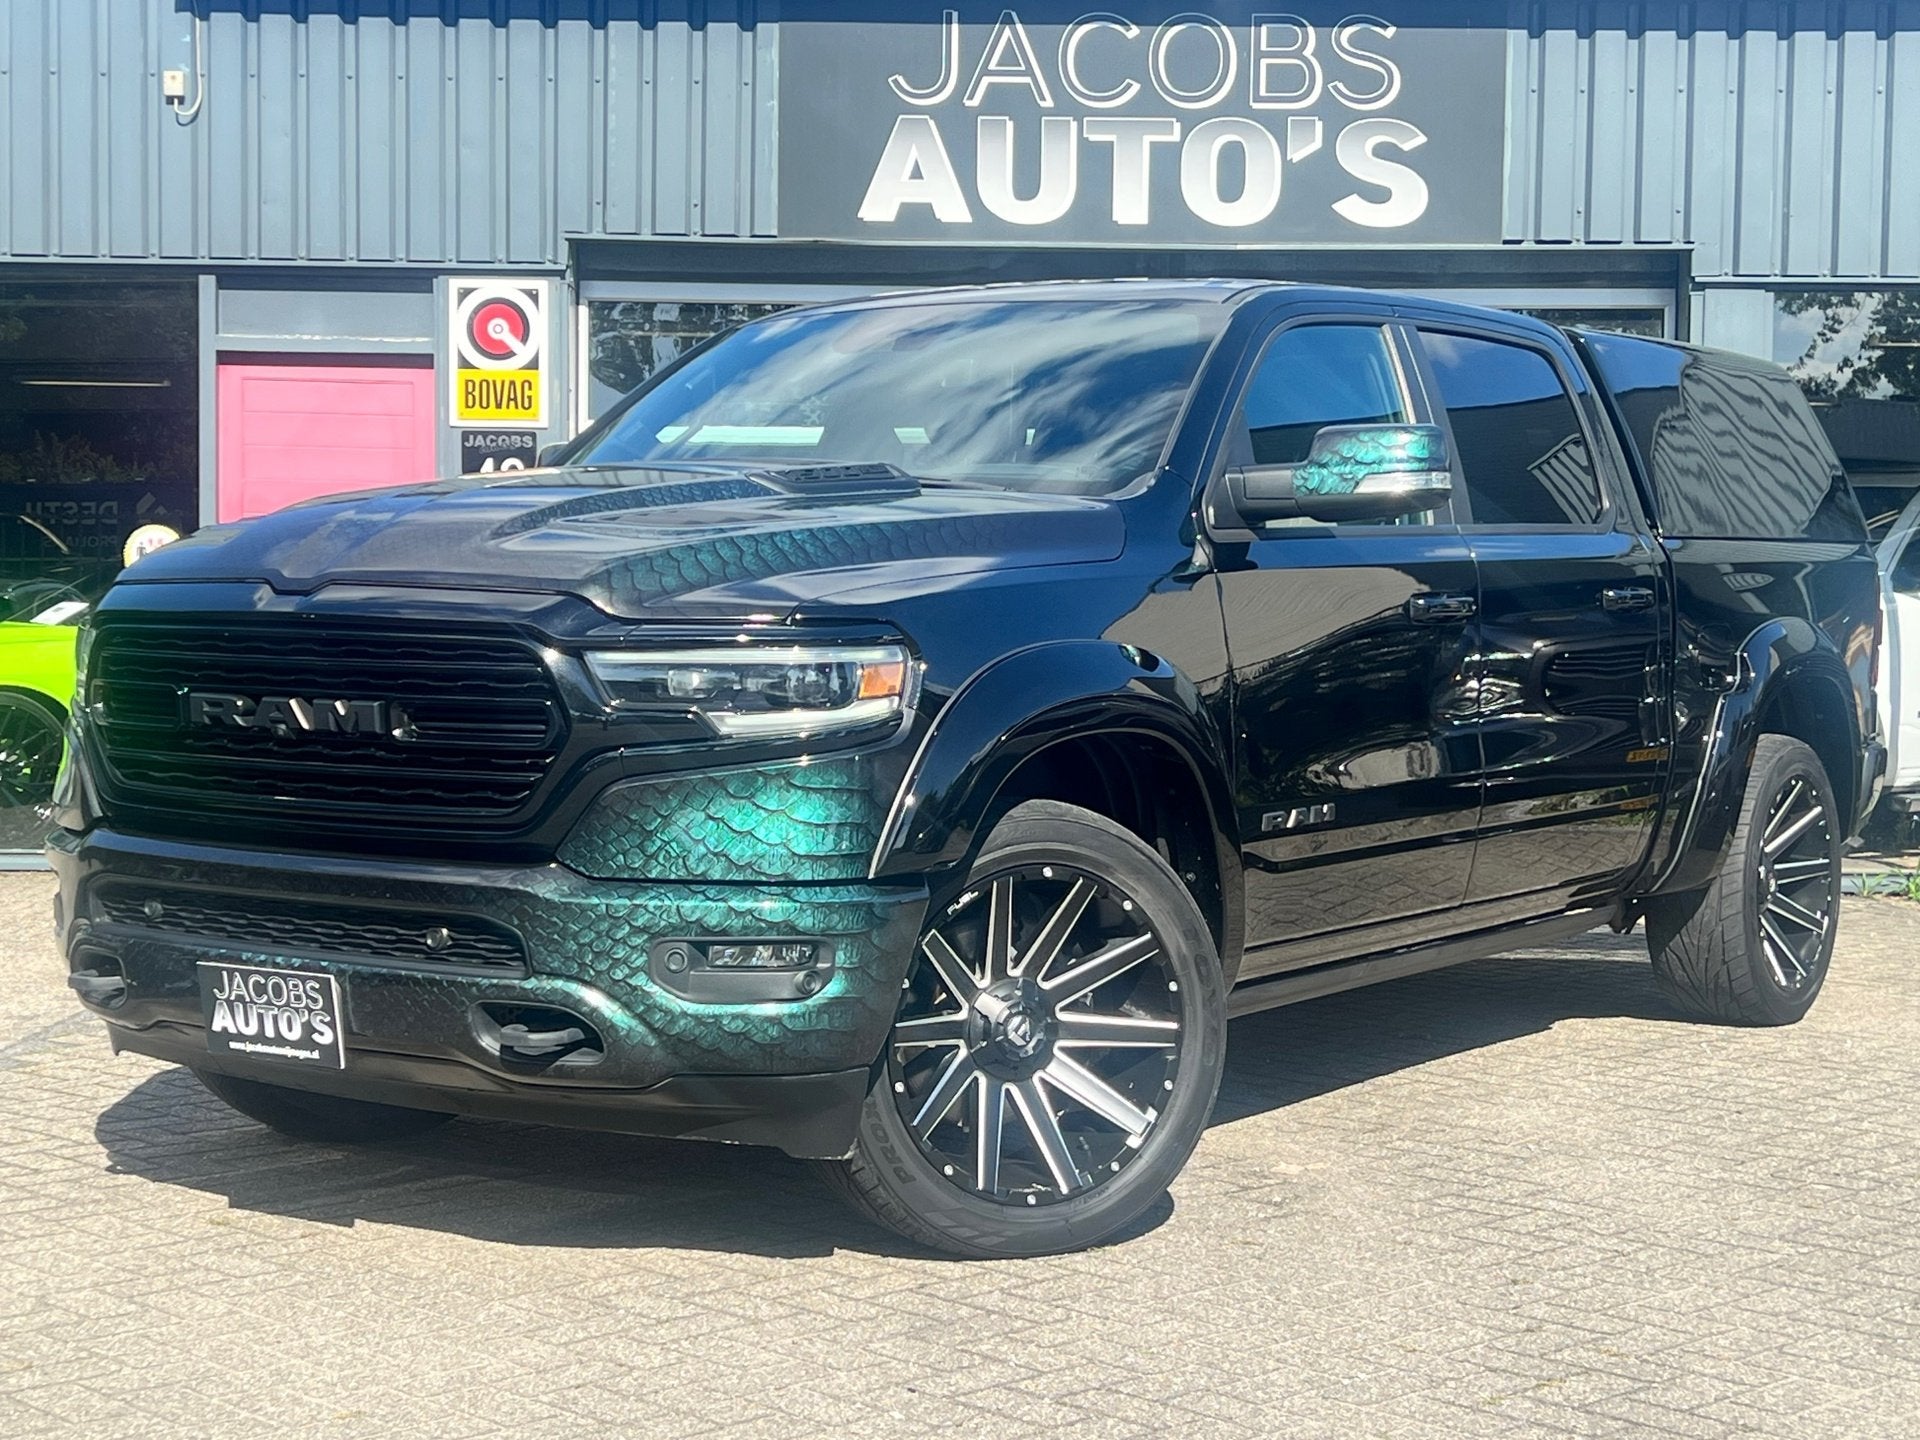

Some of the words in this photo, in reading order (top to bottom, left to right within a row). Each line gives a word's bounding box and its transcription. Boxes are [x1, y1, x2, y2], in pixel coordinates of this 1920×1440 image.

[888, 9, 1402, 109] JACOBS
[857, 115, 1430, 228] AUTO'S
[464, 378, 533, 411] BOVAG
[463, 434, 534, 449] JACOBS
[190, 693, 386, 734] RAM
[946, 891, 979, 916] FUEL
[212, 970, 324, 1010] JACOBS
[211, 1000, 335, 1045] AUTO'S
[862, 1100, 918, 1185] PROX
